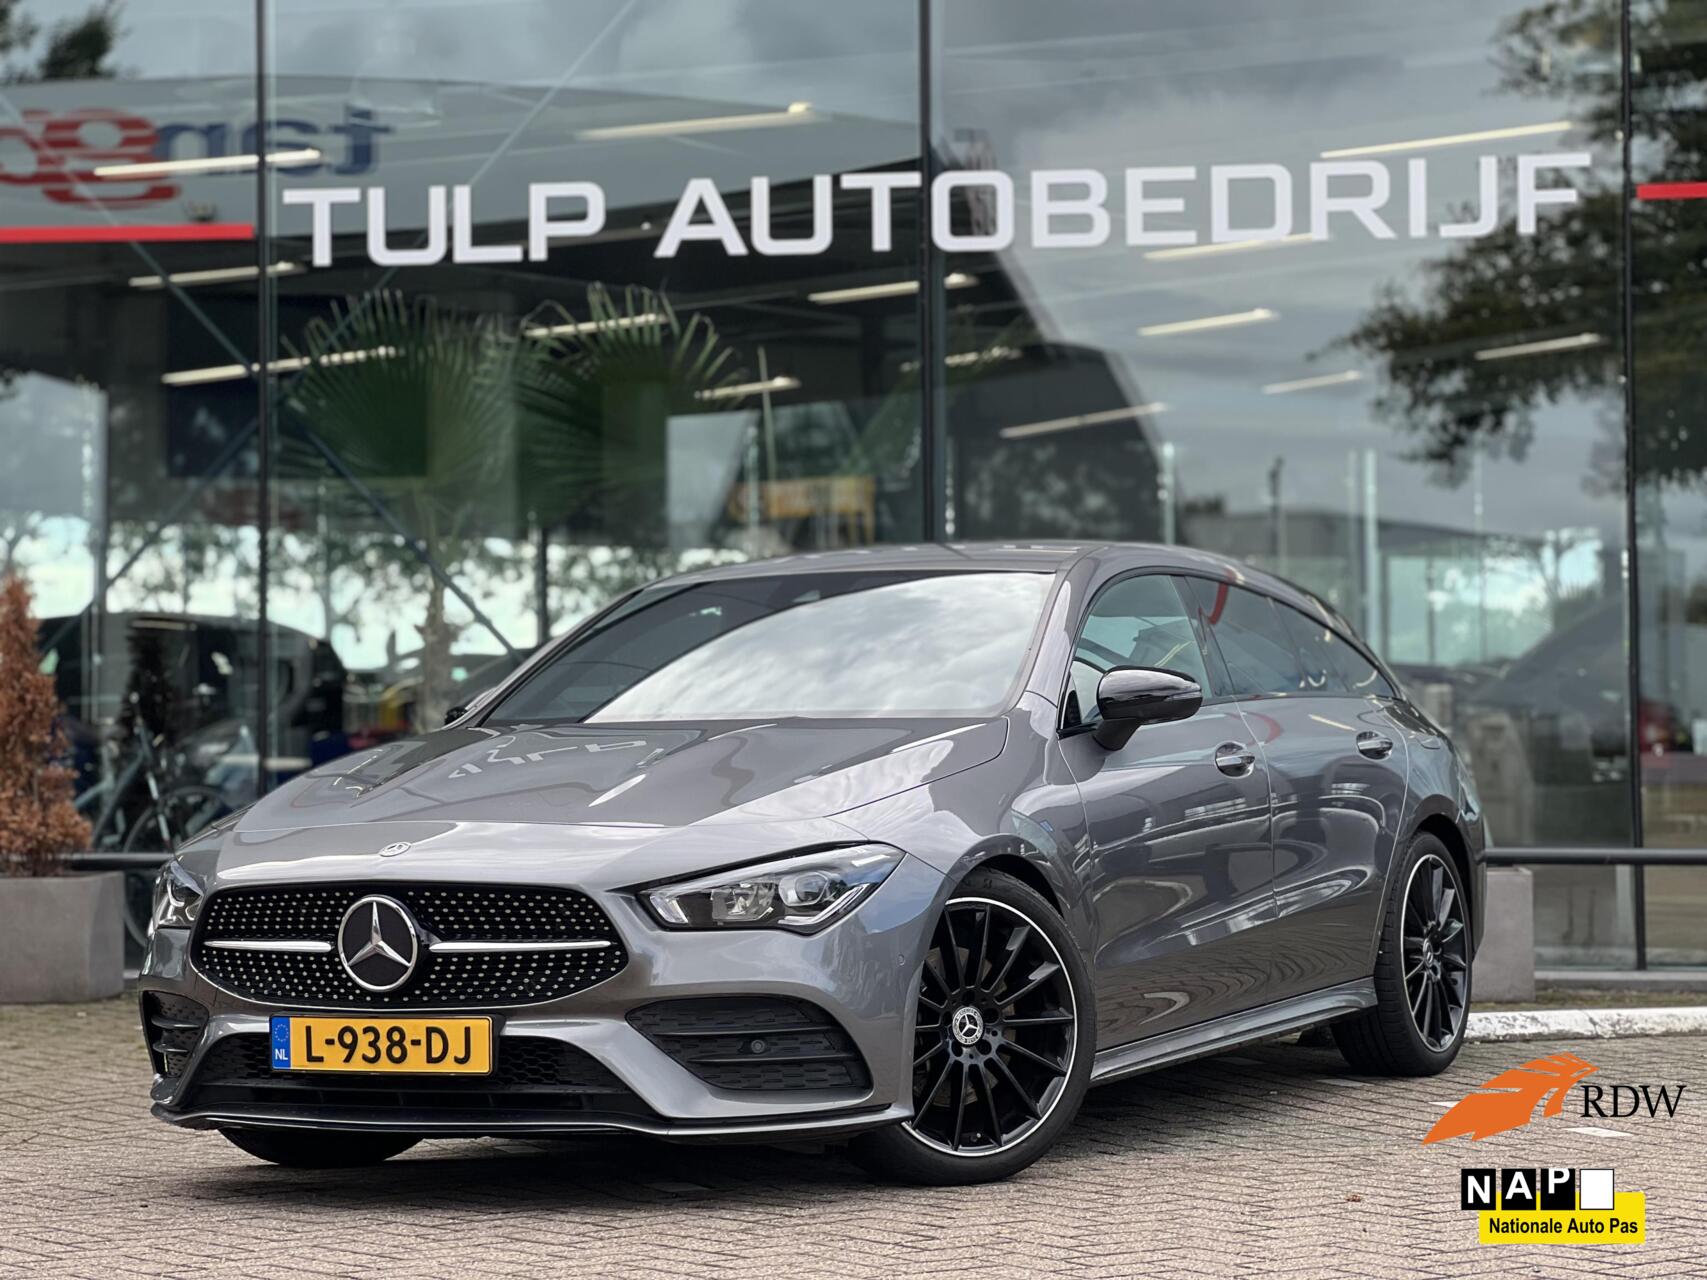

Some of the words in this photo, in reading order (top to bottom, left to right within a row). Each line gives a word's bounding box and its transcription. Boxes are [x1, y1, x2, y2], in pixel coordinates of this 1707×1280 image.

[282, 181, 606, 267] TULP
[654, 151, 1593, 258] AUTOBEDRIJF
[275, 1049, 288, 1061] NL
[305, 1025, 471, 1064] L-938-DJ
